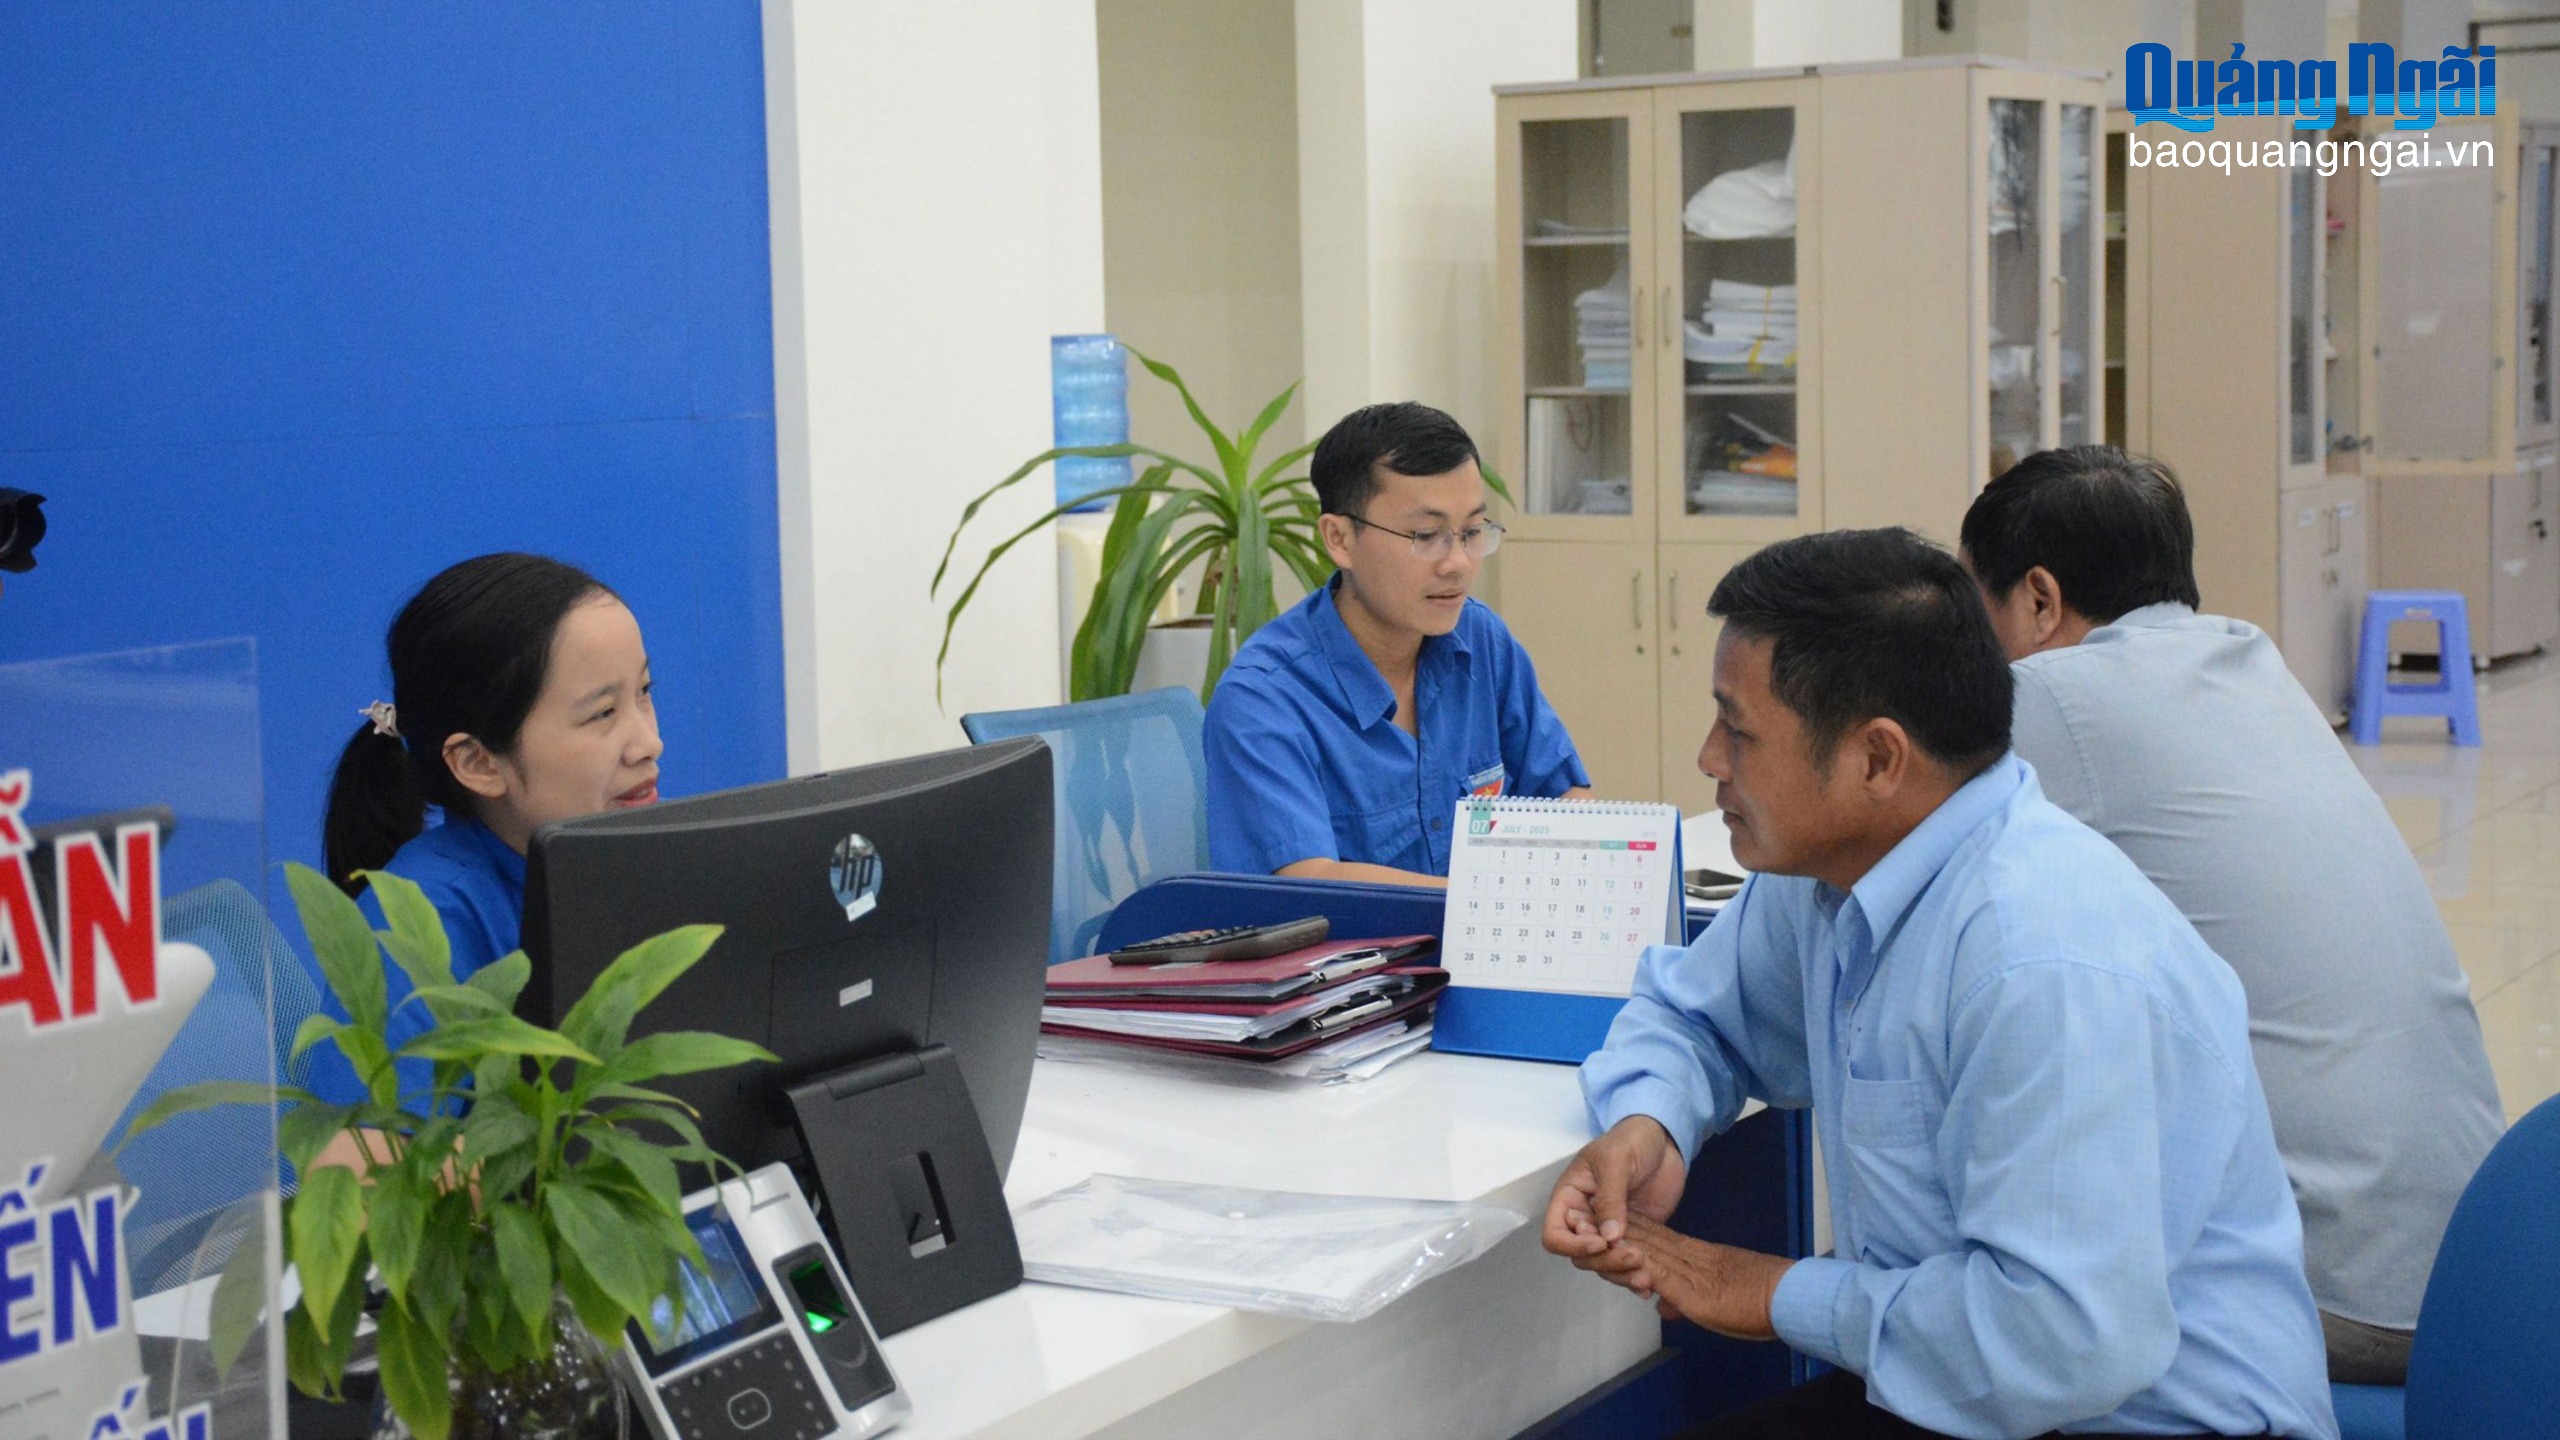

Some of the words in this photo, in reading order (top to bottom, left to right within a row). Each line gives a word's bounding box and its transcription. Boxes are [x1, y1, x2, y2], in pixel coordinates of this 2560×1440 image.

[1471, 819, 1489, 834] 07
[1502, 824, 1522, 835] JULY
[1529, 825, 1551, 836] 2025
[1550, 877, 1561, 887] 10
[1576, 878, 1587, 887] 11
[1633, 880, 1643, 890] 13
[1468, 901, 1478, 909] 14
[1495, 901, 1505, 911] 15
[1521, 902, 1531, 912] 16
[1547, 903, 1558, 912] 17
[1575, 904, 1585, 914] 18
[1629, 906, 1641, 916] 20
[1466, 926, 1476, 936] 21
[1491, 927, 1502, 937] 22
[1518, 928, 1529, 938] 23
[1545, 929, 1555, 938] 24
[1571, 930, 1583, 940] 25
[1627, 933, 1638, 942] 27
[1464, 952, 1475, 961] 28
[1489, 953, 1501, 963] 29
[1516, 954, 1527, 964] 30
[1543, 955, 1553, 965] 31
